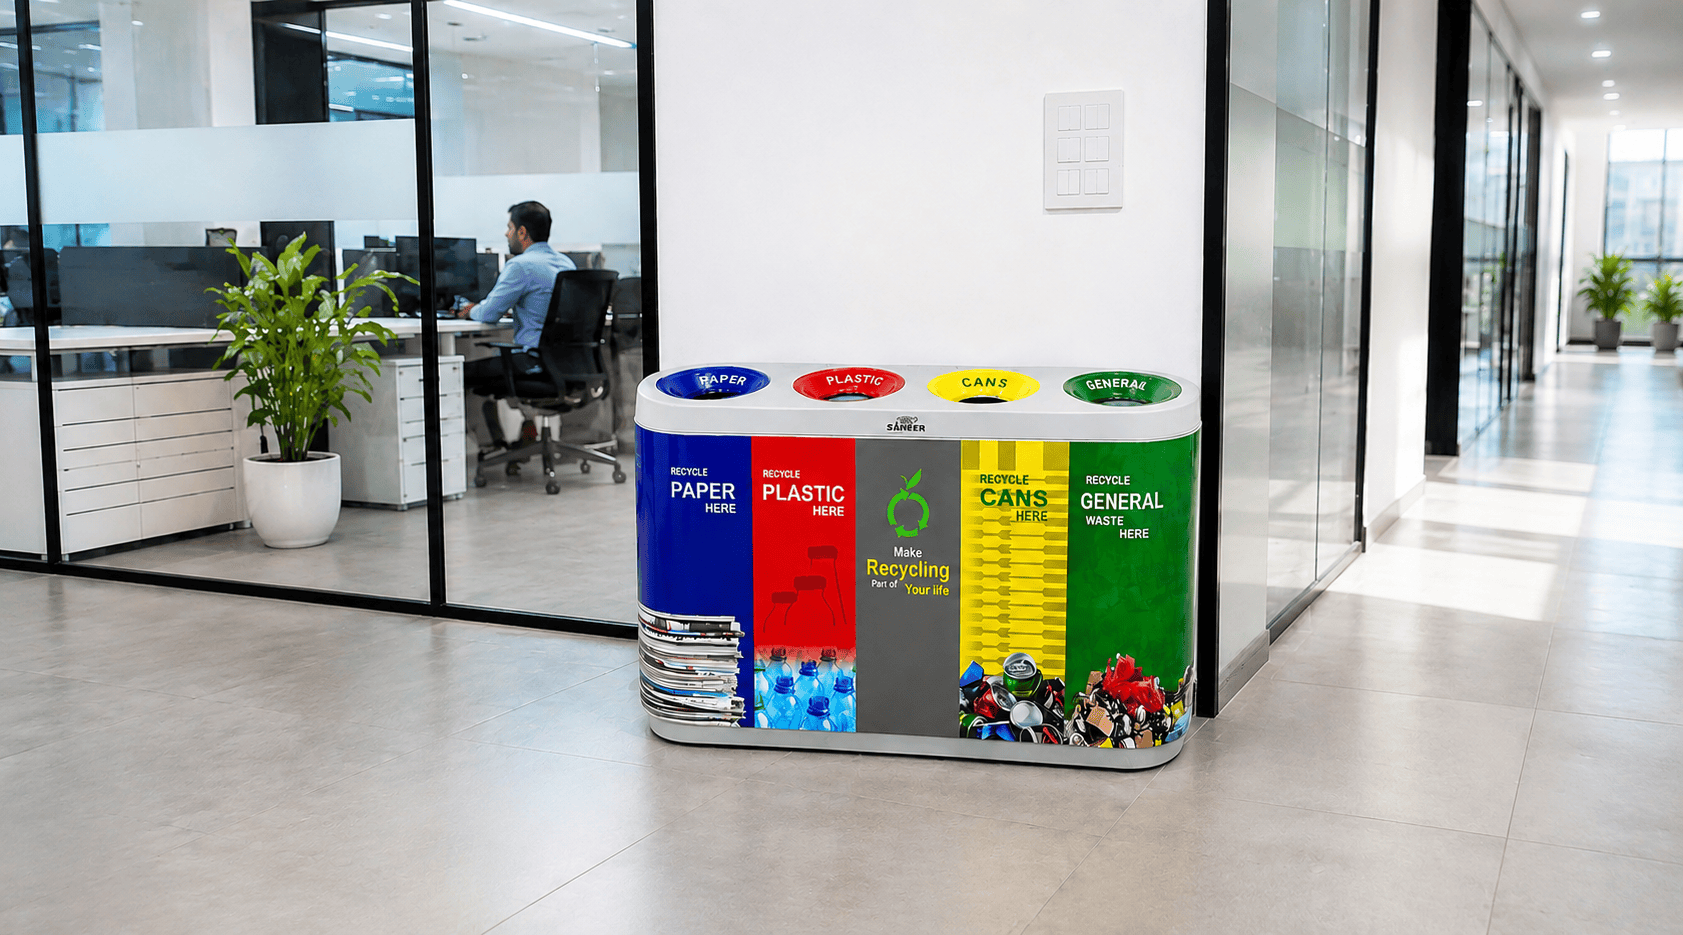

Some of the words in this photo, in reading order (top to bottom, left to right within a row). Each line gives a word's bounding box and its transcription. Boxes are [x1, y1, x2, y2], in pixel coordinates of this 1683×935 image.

[698, 374, 748, 387] PAPER
[826, 374, 884, 386] PLASTIC
[961, 377, 1008, 389] CANS
[670, 467, 708, 477] RECYCLE
[762, 469, 801, 479] RECYCLE
[979, 473, 1029, 485] RECYCLE
[1085, 475, 1131, 485] RECYCLE
[670, 481, 736, 500] PAPER
[762, 484, 845, 503] PLASTIC
[980, 488, 1048, 507] CANS
[1080, 491, 1164, 510] GENERAL
[705, 503, 737, 514] HERE
[812, 506, 845, 517] HERE
[1016, 510, 1048, 522] HERE
[1085, 515, 1124, 526] WASTE
[1119, 528, 1149, 539] HERE
[893, 546, 923, 558] Make
[866, 558, 950, 583] Recycling
[871, 579, 887, 588] Part
[888, 579, 898, 588] of
[904, 583, 931, 595] Your
[932, 584, 950, 596] life
